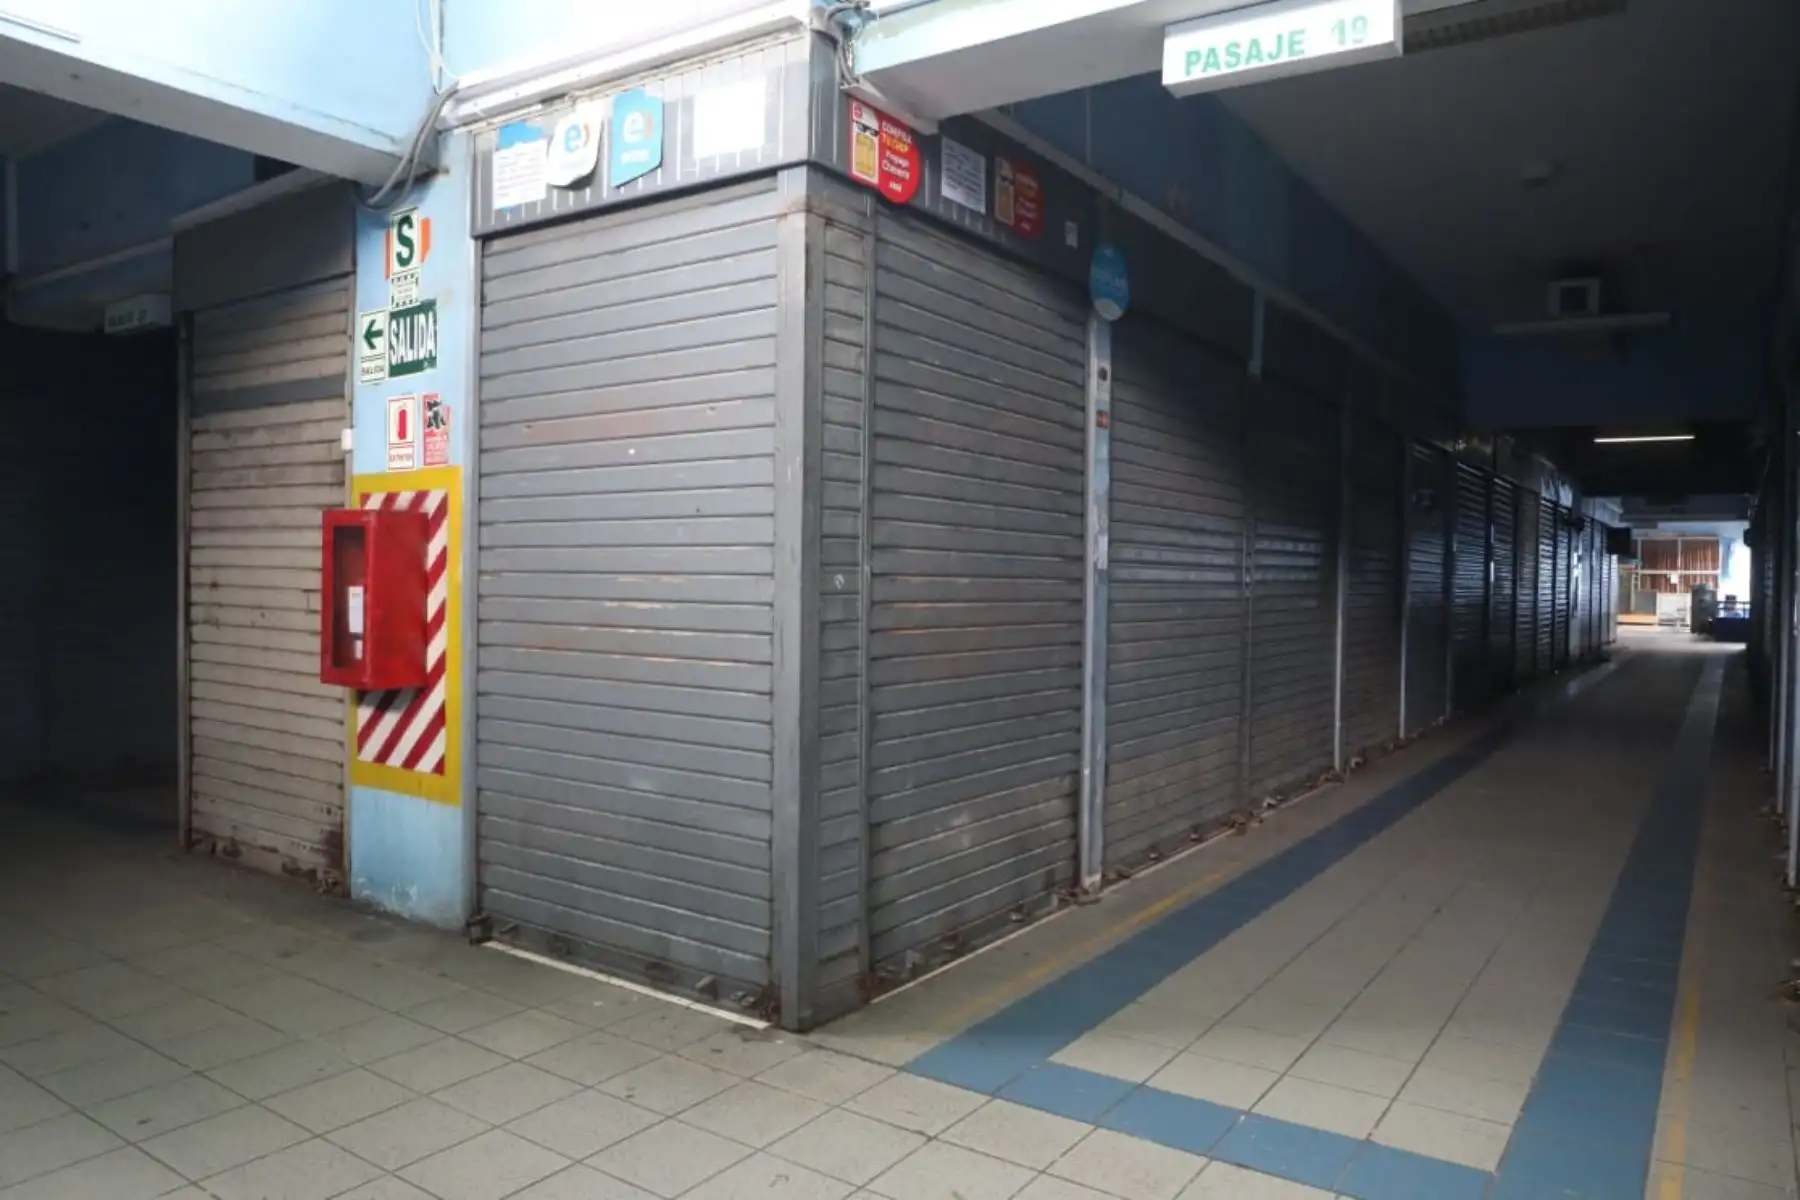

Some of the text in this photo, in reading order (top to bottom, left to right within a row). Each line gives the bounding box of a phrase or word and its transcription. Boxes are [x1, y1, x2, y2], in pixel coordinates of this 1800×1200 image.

[1185, 16, 1369, 76] PASAJE 19
[396, 214, 415, 268] S
[389, 311, 436, 366] SALIDA
